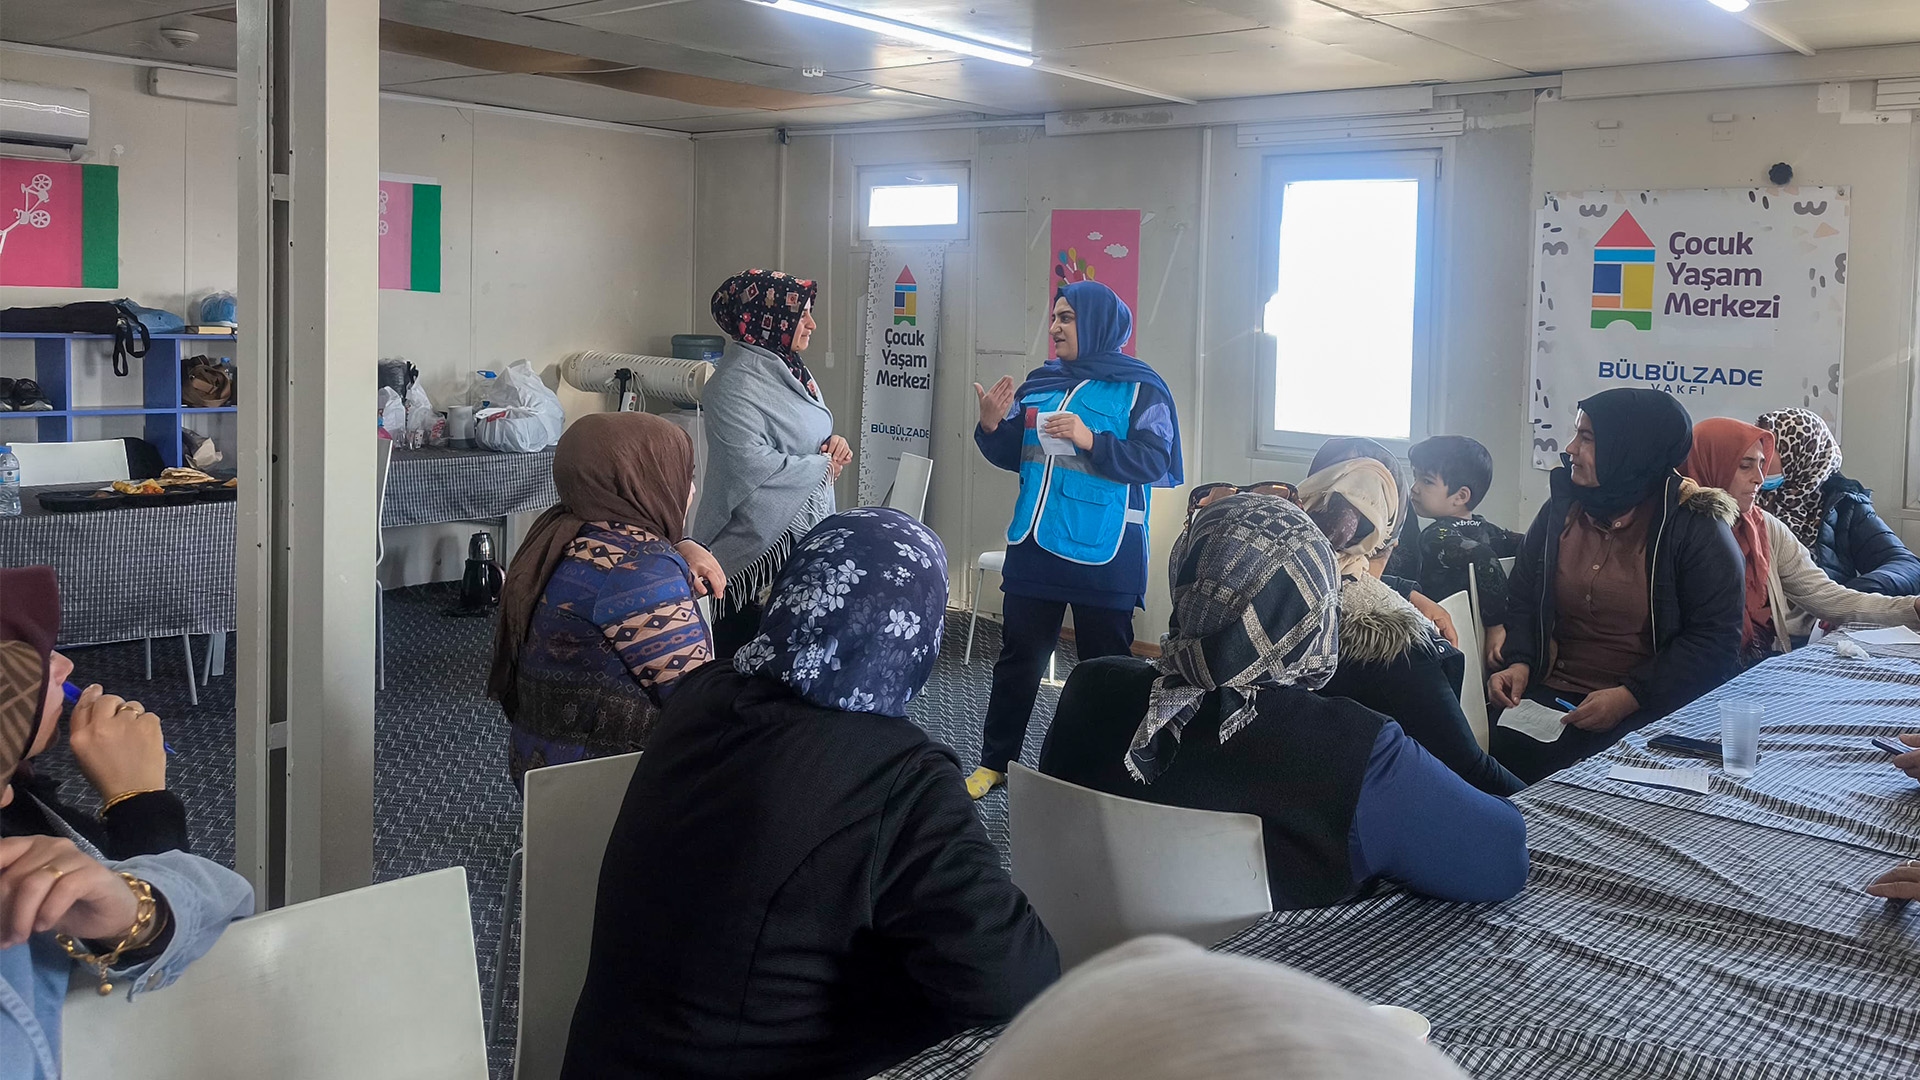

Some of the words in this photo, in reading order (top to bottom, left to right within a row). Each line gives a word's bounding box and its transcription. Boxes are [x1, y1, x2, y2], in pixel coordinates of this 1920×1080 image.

[1668, 231, 1754, 260] Çocuk
[1666, 262, 1762, 291] Yaşam
[1664, 293, 1781, 319] Merkezi
[884, 328, 925, 348] Çocuk
[882, 349, 927, 370] Yaşam
[876, 369, 931, 390] Merkezi
[1598, 359, 1763, 387] BÜLBÜLZADE
[1651, 383, 1705, 395] VAKFI
[871, 422, 930, 439] BÜLBÜLZADE
